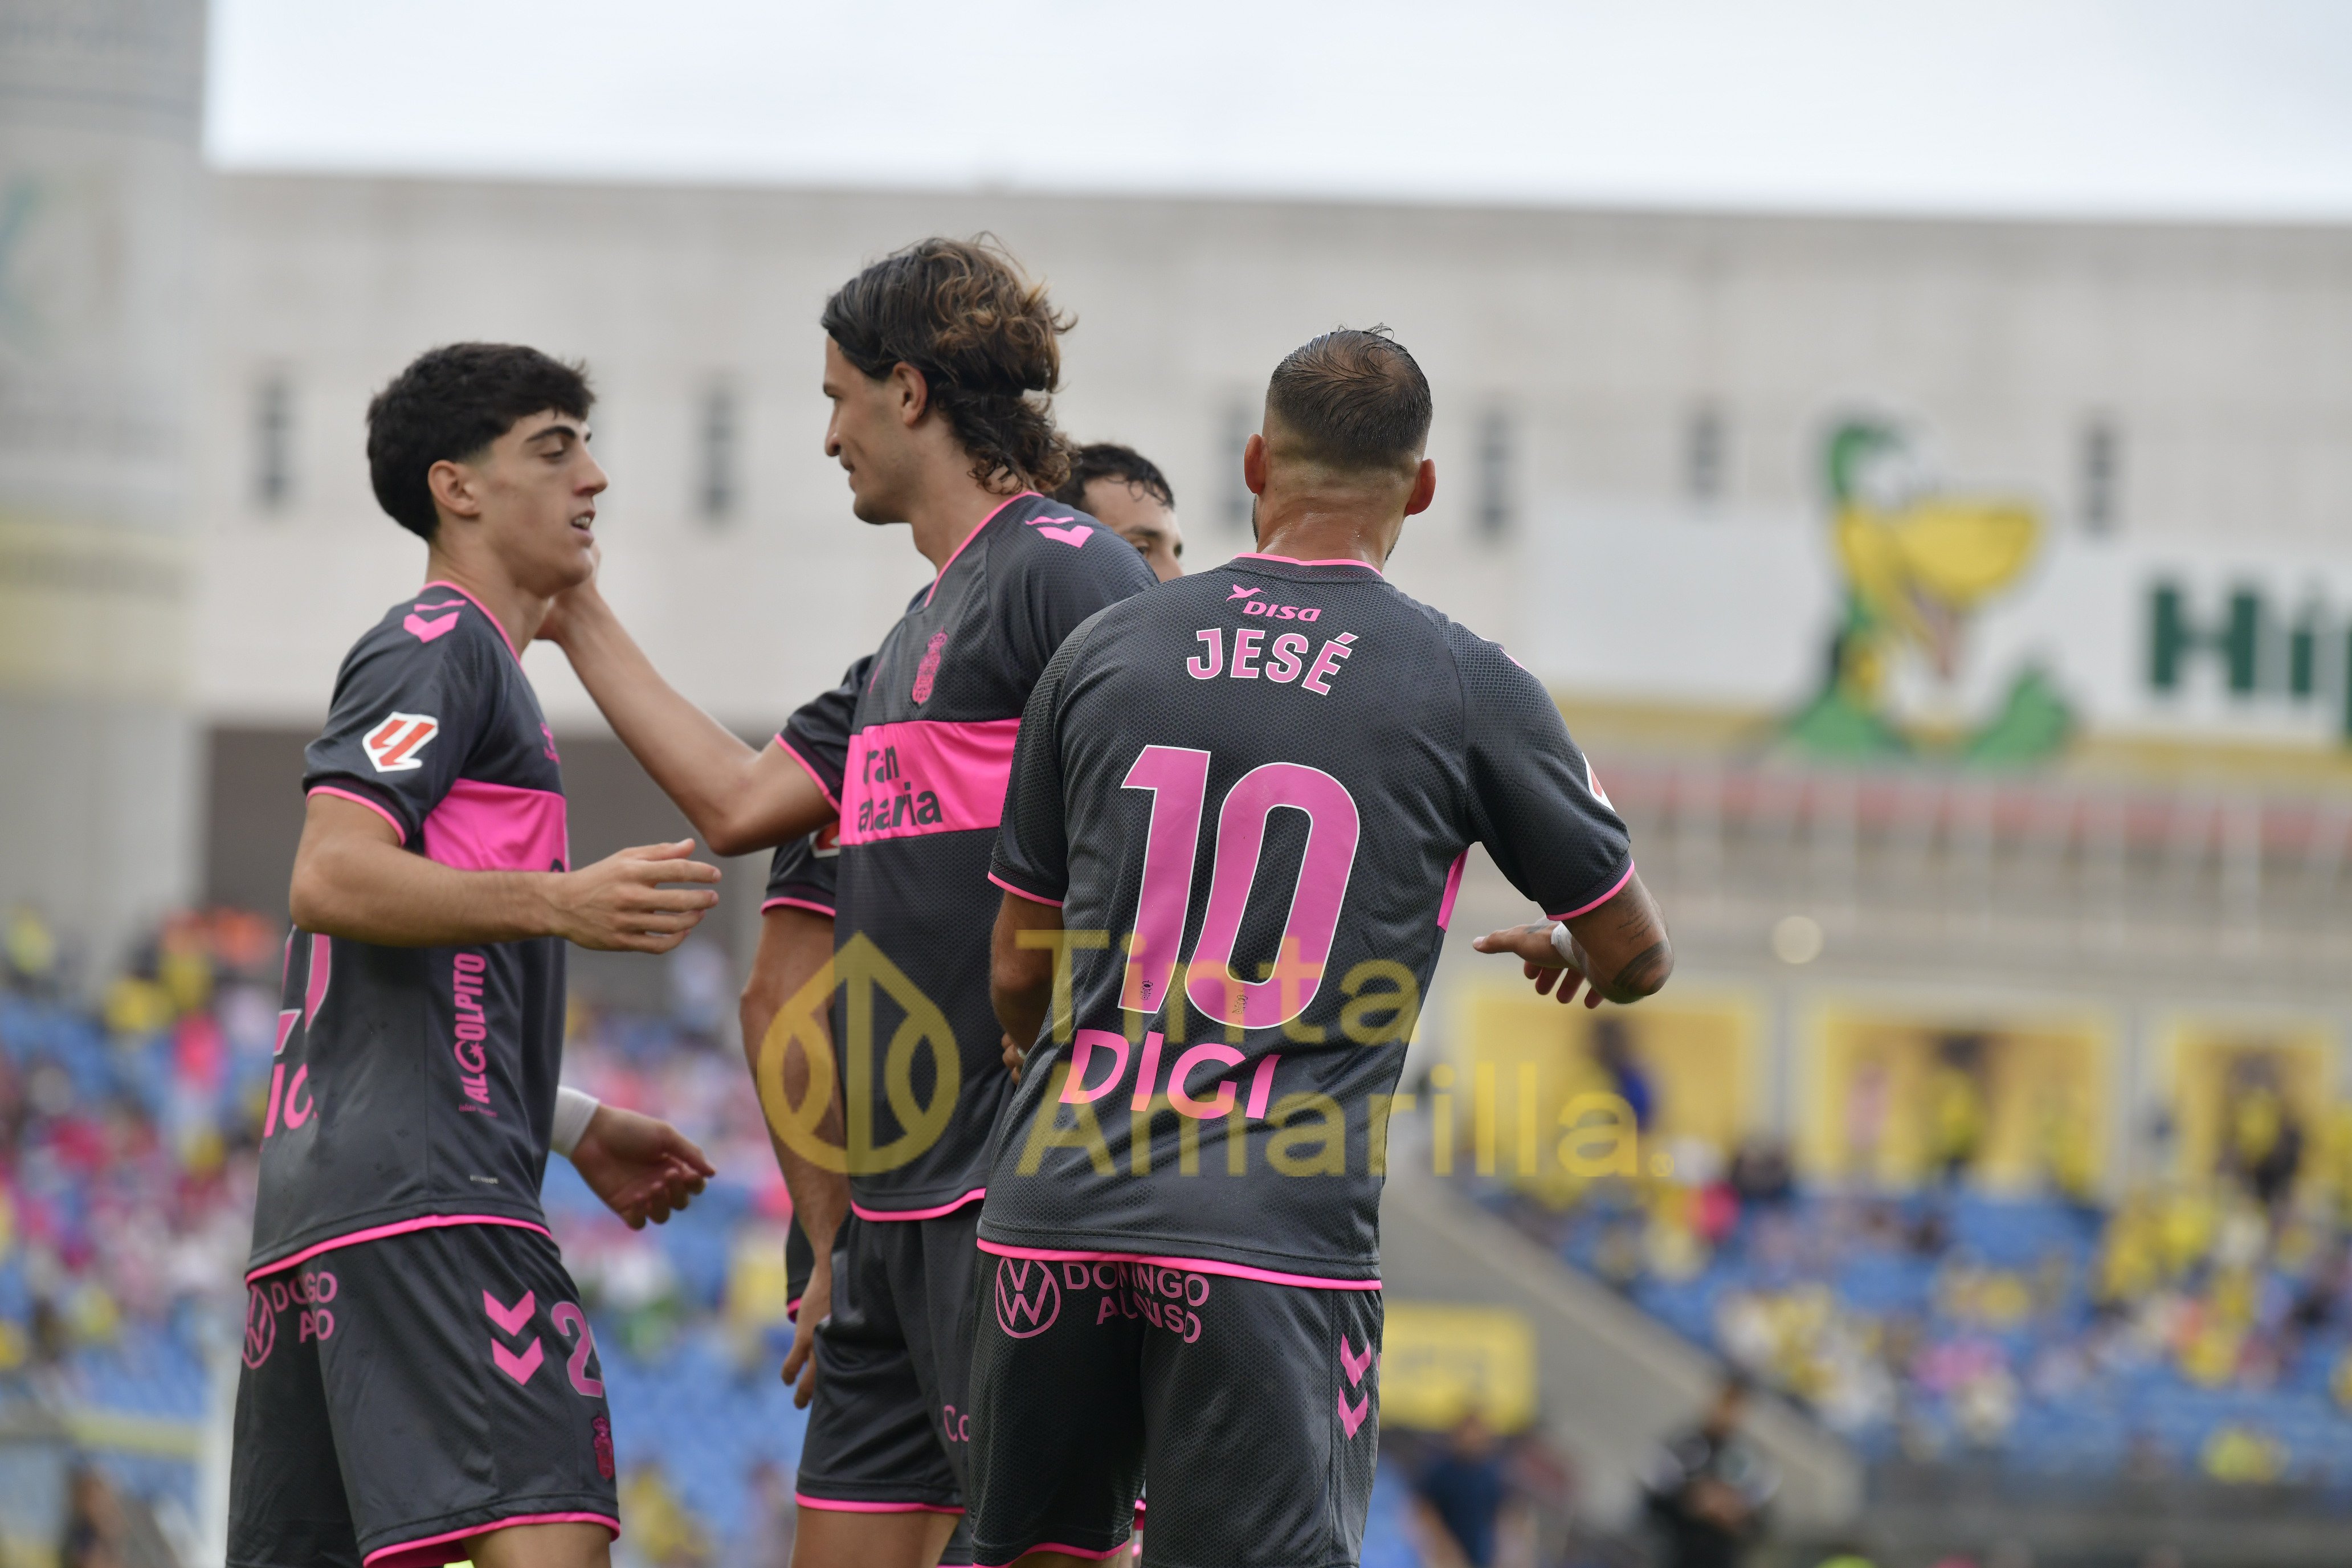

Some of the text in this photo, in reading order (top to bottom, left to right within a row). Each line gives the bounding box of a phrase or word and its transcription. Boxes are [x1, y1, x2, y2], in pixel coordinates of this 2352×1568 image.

[1186, 627, 1359, 696] JESÉ
[863, 746, 900, 785] ran
[1117, 745, 1360, 1030] 10
[1058, 1028, 1282, 1120] DIGI
[550, 1301, 604, 1398] 2
